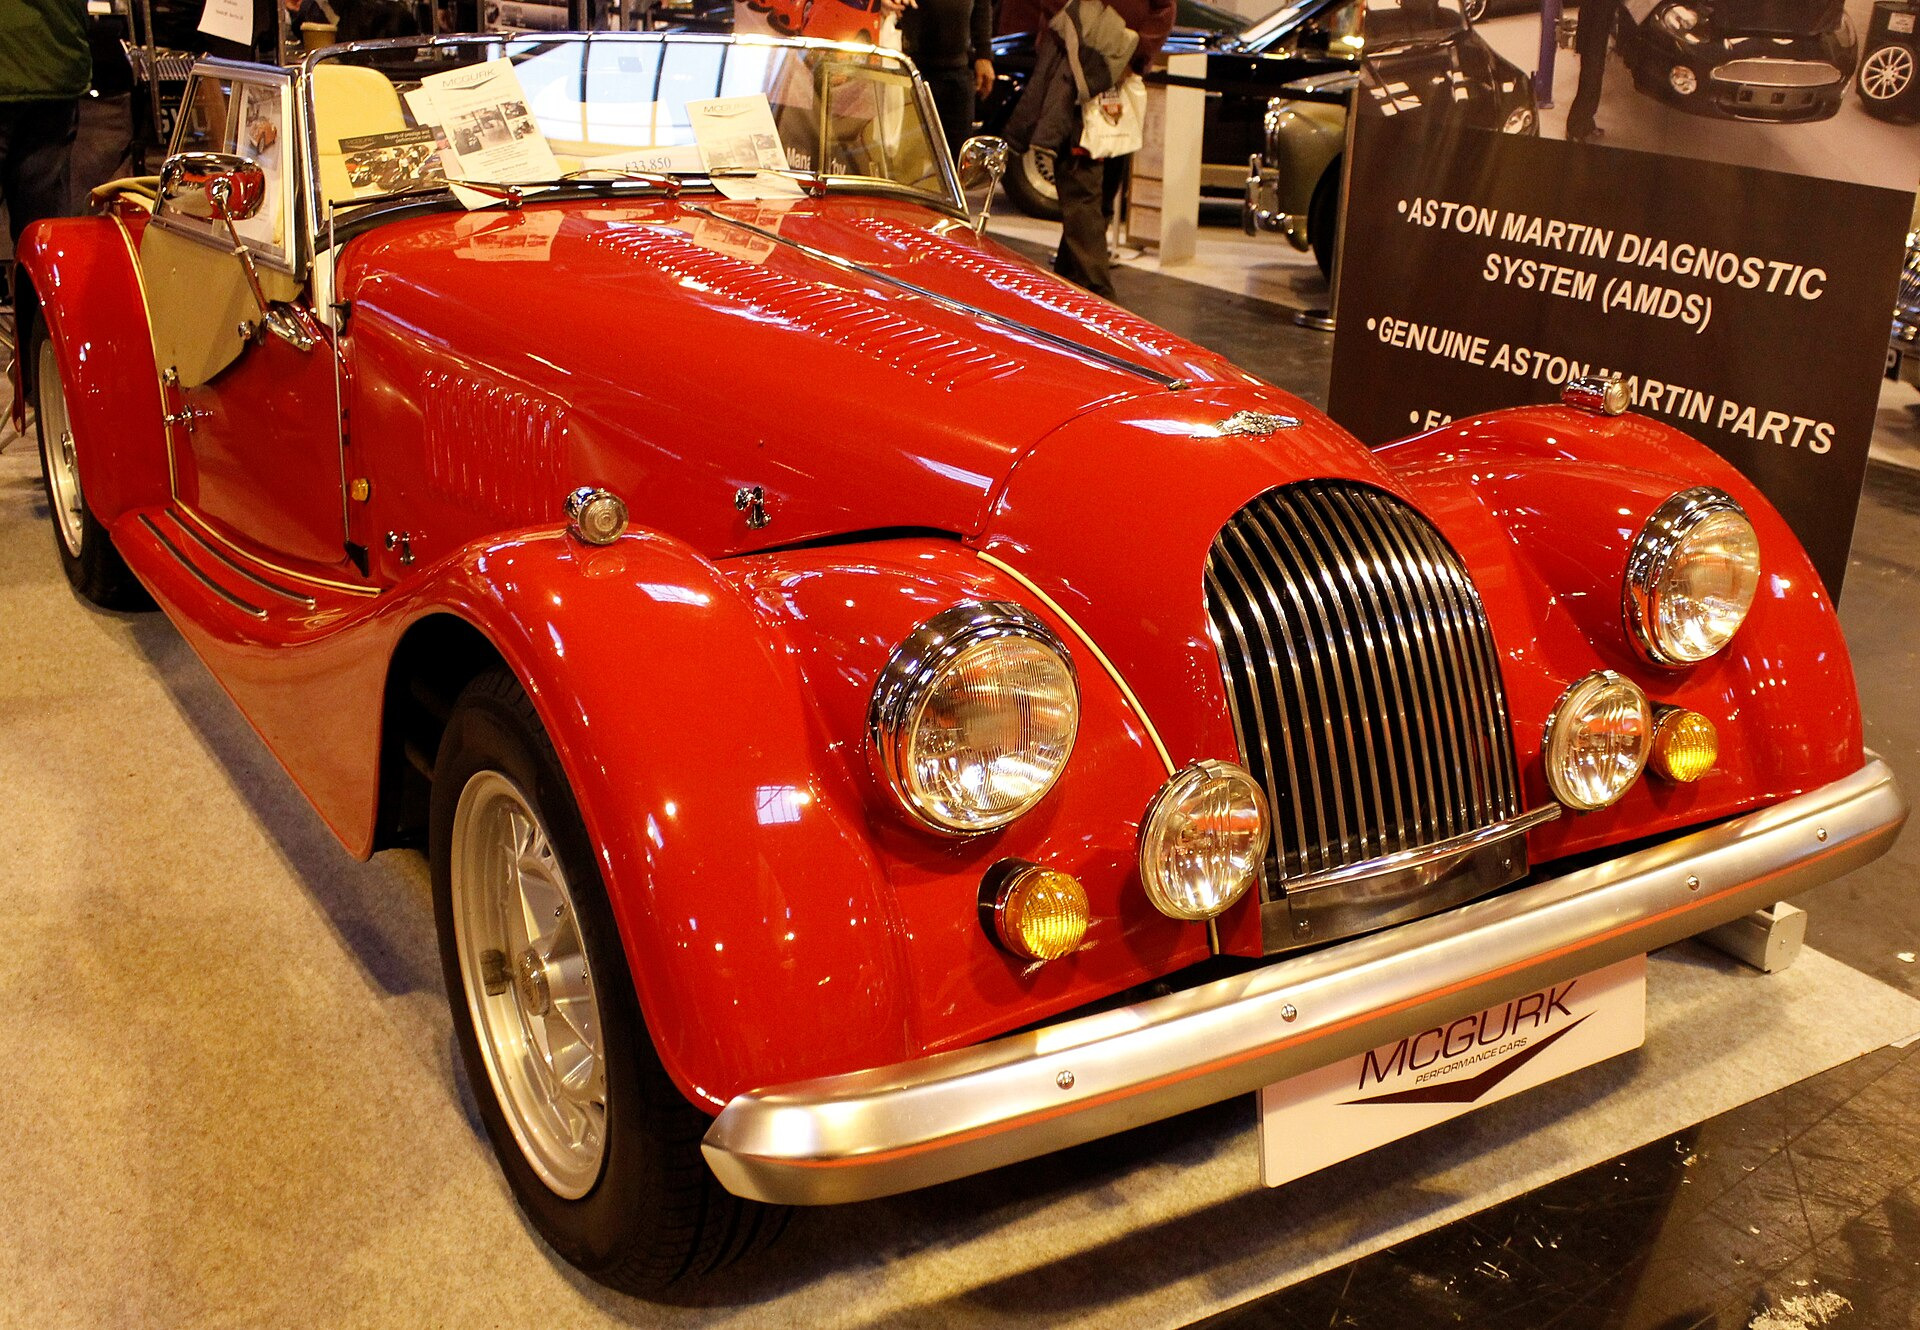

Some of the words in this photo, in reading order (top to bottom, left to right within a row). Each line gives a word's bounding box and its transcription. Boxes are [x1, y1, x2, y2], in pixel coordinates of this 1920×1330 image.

[442, 68, 495, 88] MCGURK
[1407, 198, 1497, 236] ASTON
[1501, 213, 1613, 258] MARTIN
[1617, 234, 1826, 300] DIAGNOSTIC
[1483, 254, 1597, 301] SYSTEM
[1603, 278, 1711, 334] (AMDS)
[1379, 317, 1489, 365] GENUINE
[1490, 344, 1590, 384] ASTON
[1718, 400, 1835, 453] PARTS
[1358, 980, 1577, 1090] MCGURK
[1415, 1048, 1497, 1084] PERFORMANCE
[1498, 1037, 1528, 1055] CARS
